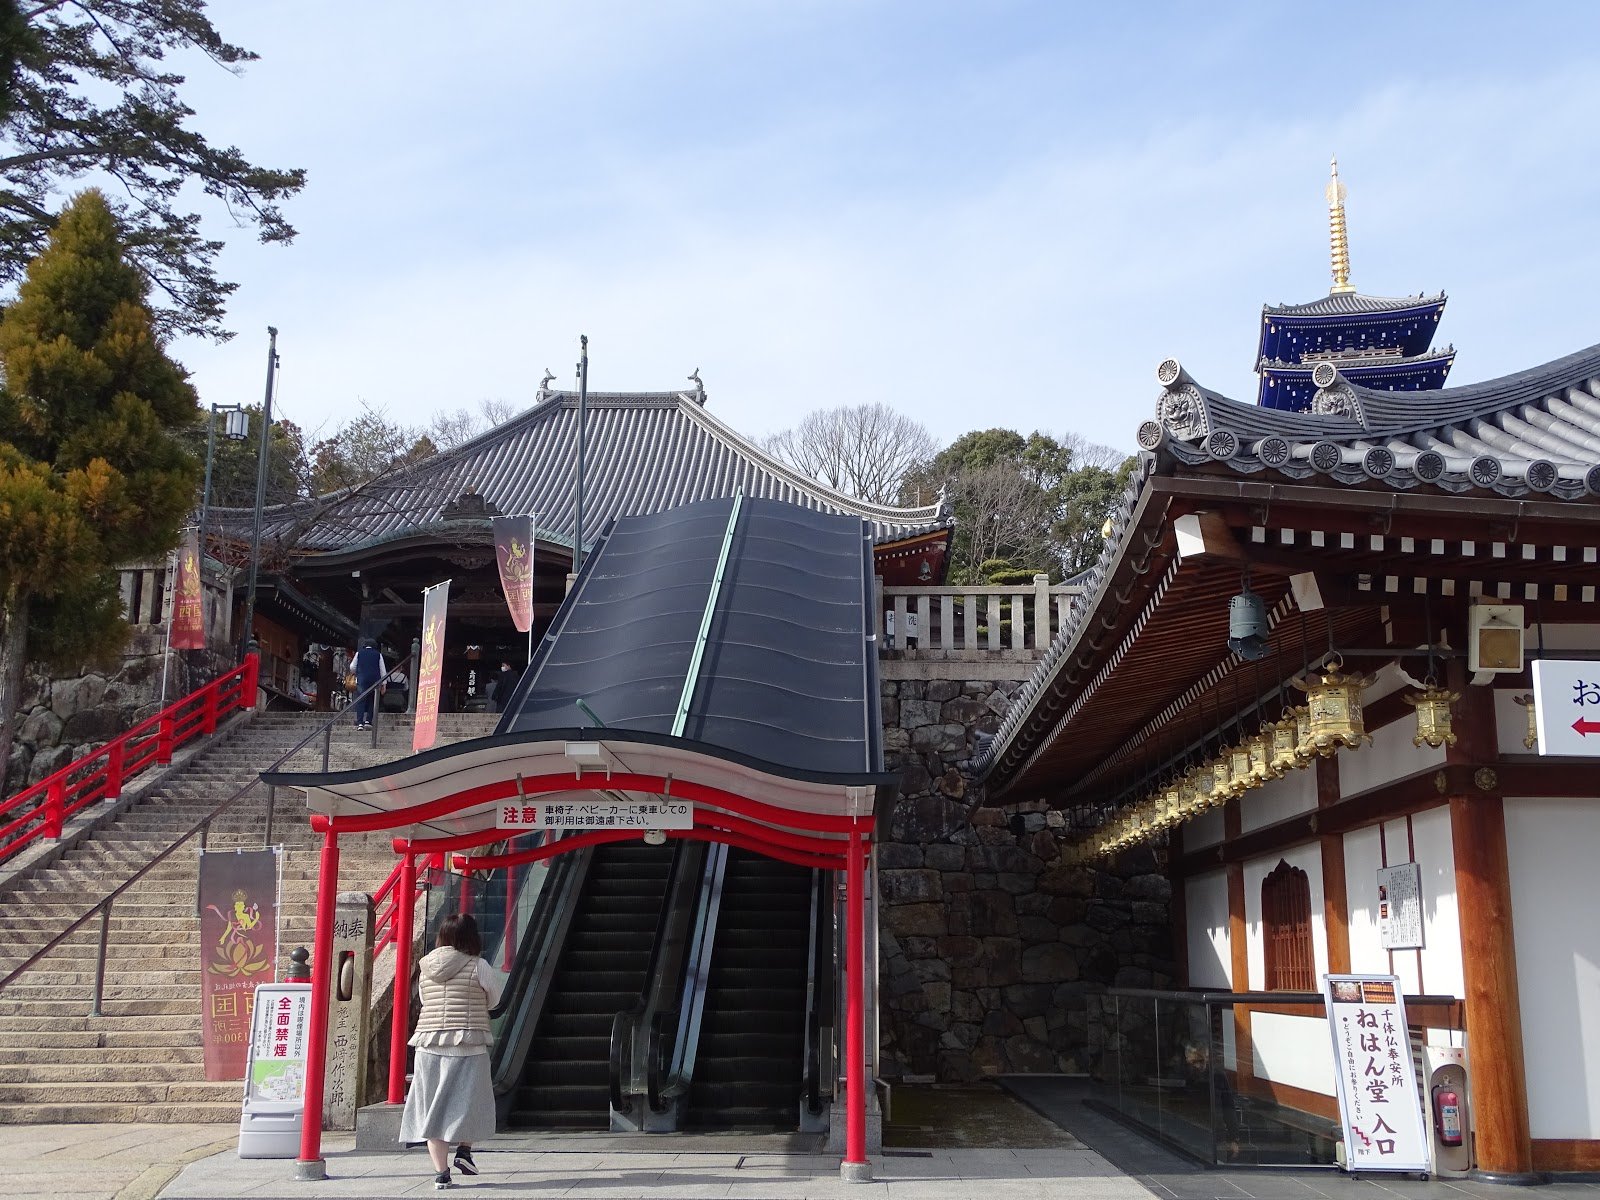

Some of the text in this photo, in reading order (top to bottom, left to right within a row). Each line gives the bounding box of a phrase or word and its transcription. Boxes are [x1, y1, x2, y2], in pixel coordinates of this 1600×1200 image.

[503, 806, 537, 824] 注意
[544, 815, 650, 826] 御利用は御遠慮下さい。
[273, 996, 292, 1057] 全面禁煙
[1381, 1009, 1404, 1088] 千体仏奉安所
[1356, 1008, 1397, 1155] ねはん堂 入口
